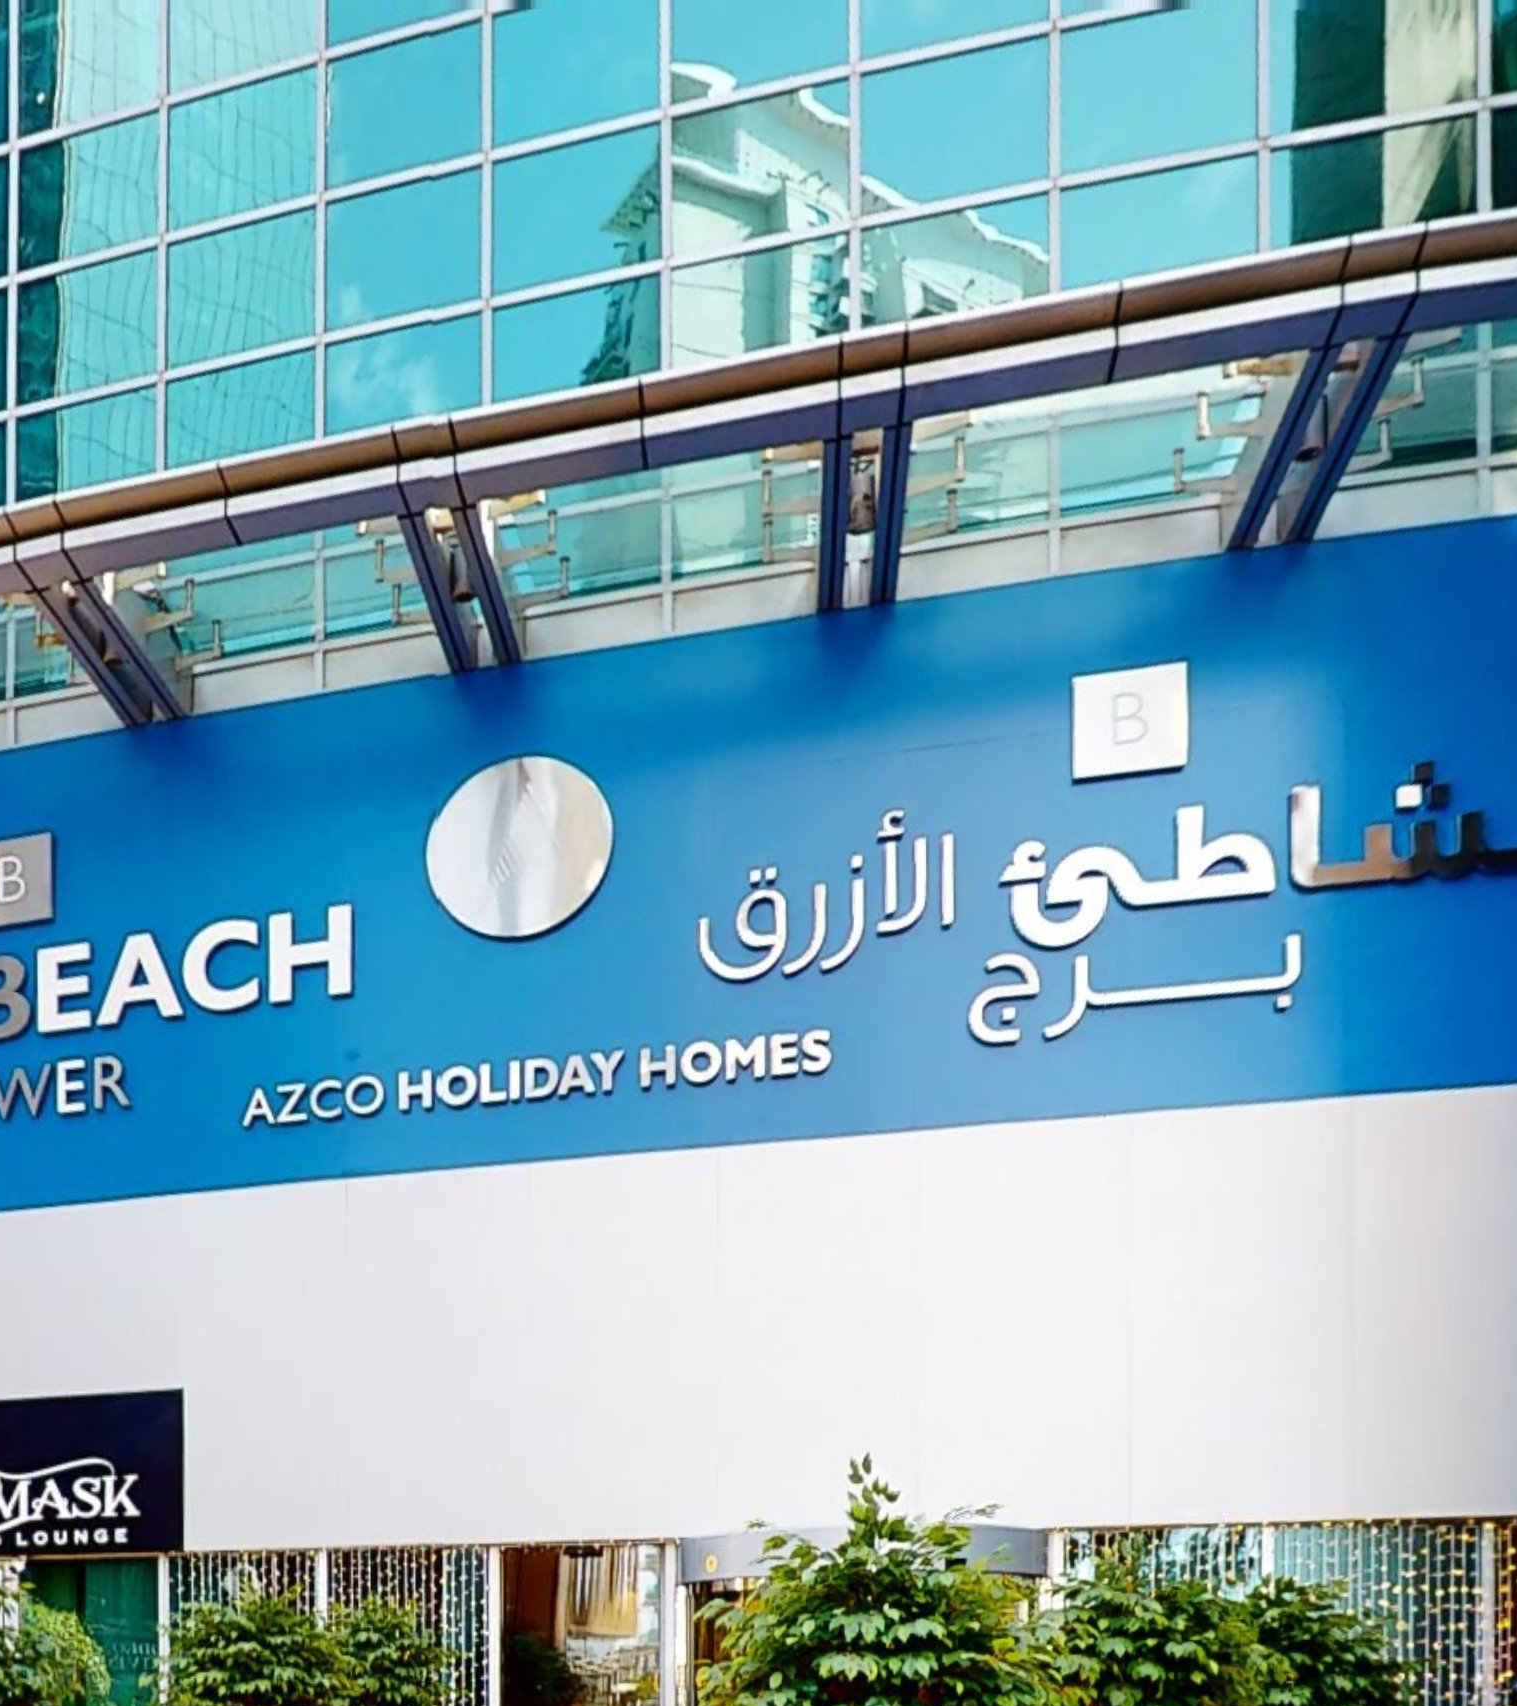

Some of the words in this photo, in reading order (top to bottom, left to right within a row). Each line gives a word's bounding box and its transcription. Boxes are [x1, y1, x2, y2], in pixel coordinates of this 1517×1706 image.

[1109, 690, 1148, 747] B
[697, 808, 957, 982] الأزرق
[967, 931, 1305, 1046] برج
[241, 1079, 385, 1128] AZCO
[397, 1050, 625, 1113] HOLIDAY
[639, 1029, 833, 1088] HOMES
[16, 1528, 129, 1546] LOUNGE
